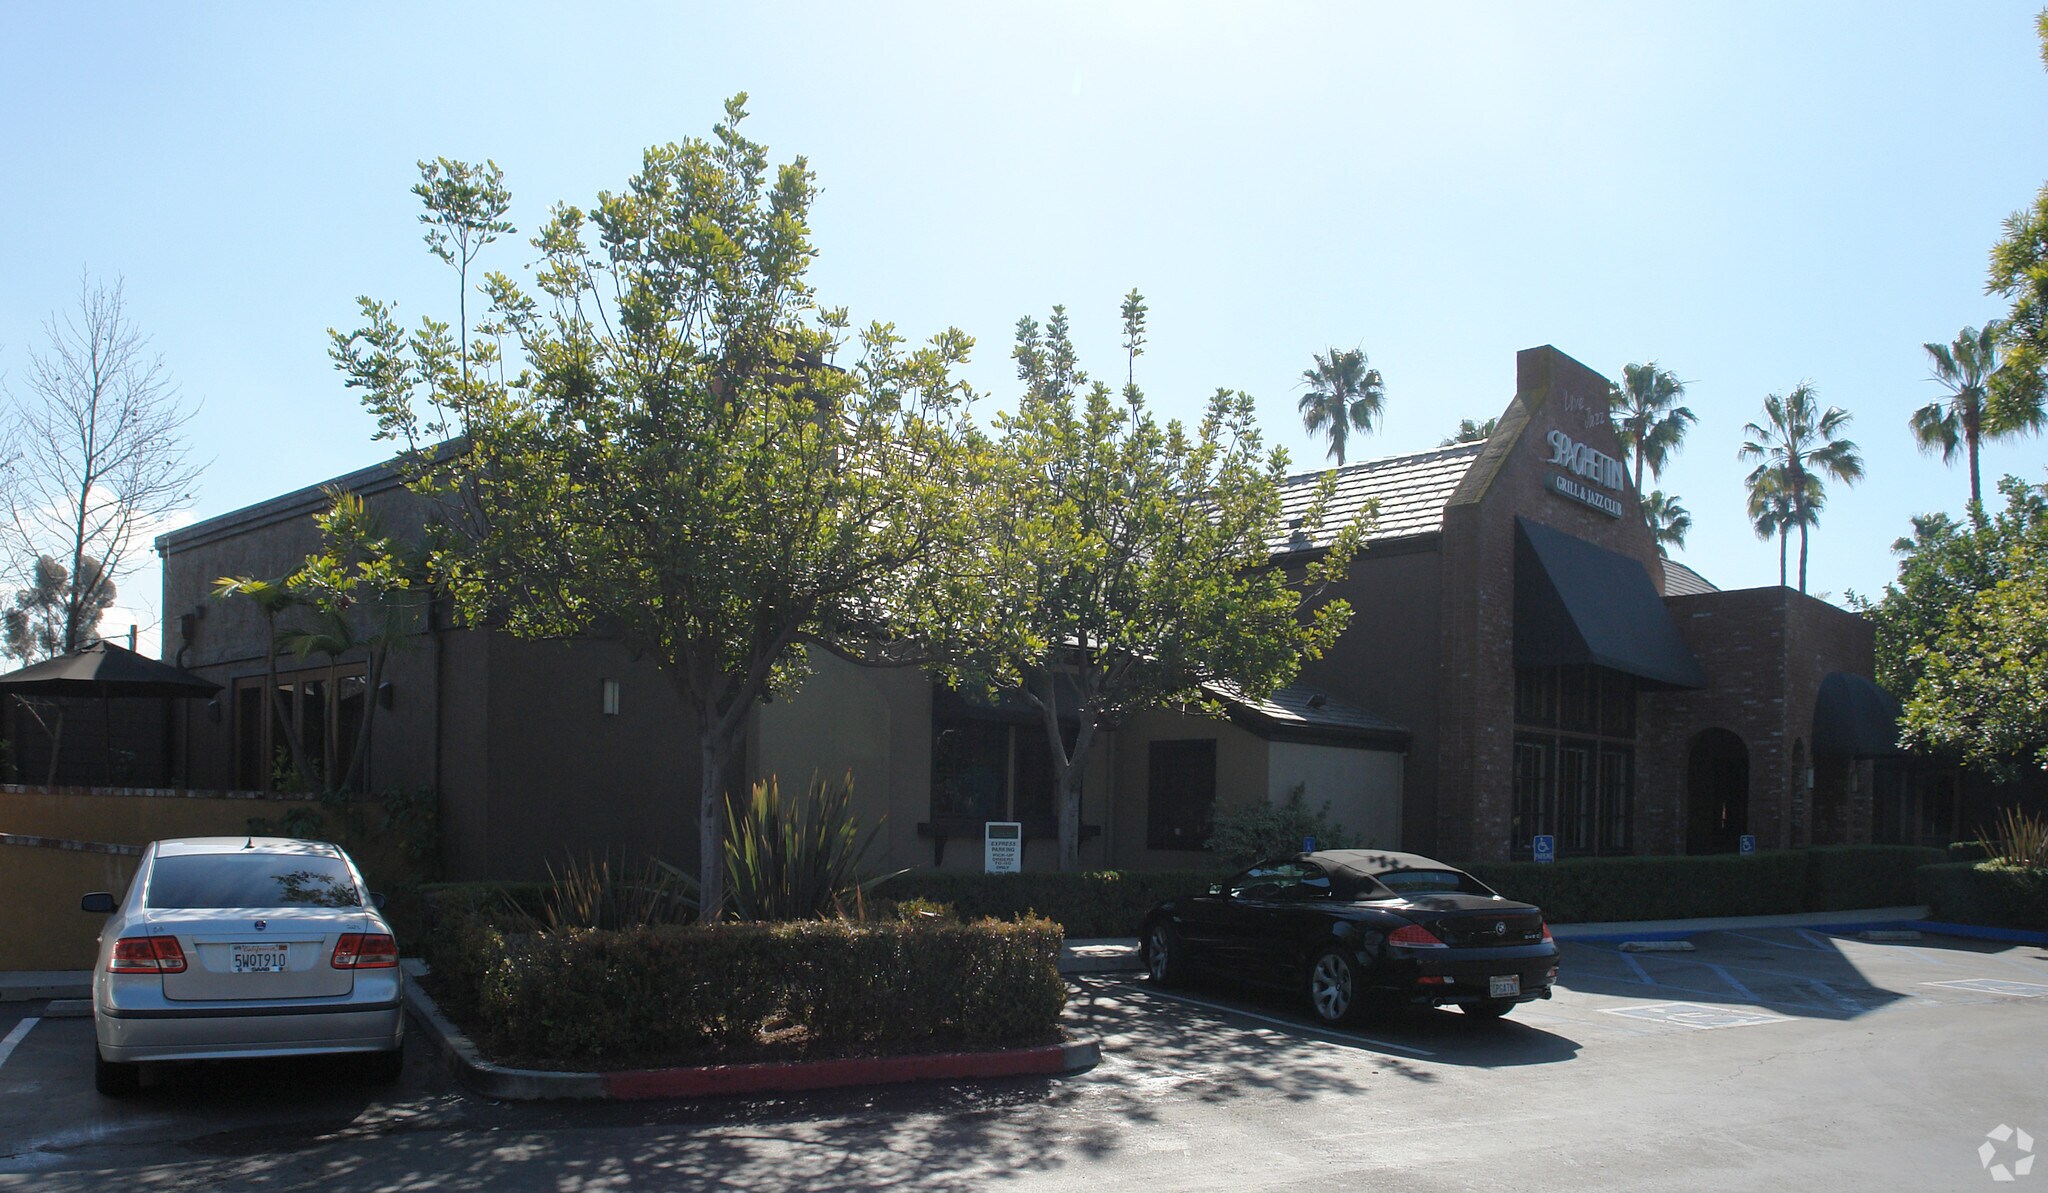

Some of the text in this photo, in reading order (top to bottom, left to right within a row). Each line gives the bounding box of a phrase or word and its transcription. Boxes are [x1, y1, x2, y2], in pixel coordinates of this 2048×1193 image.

[1556, 476, 1622, 515] GRILL & JAZZ CLUB
